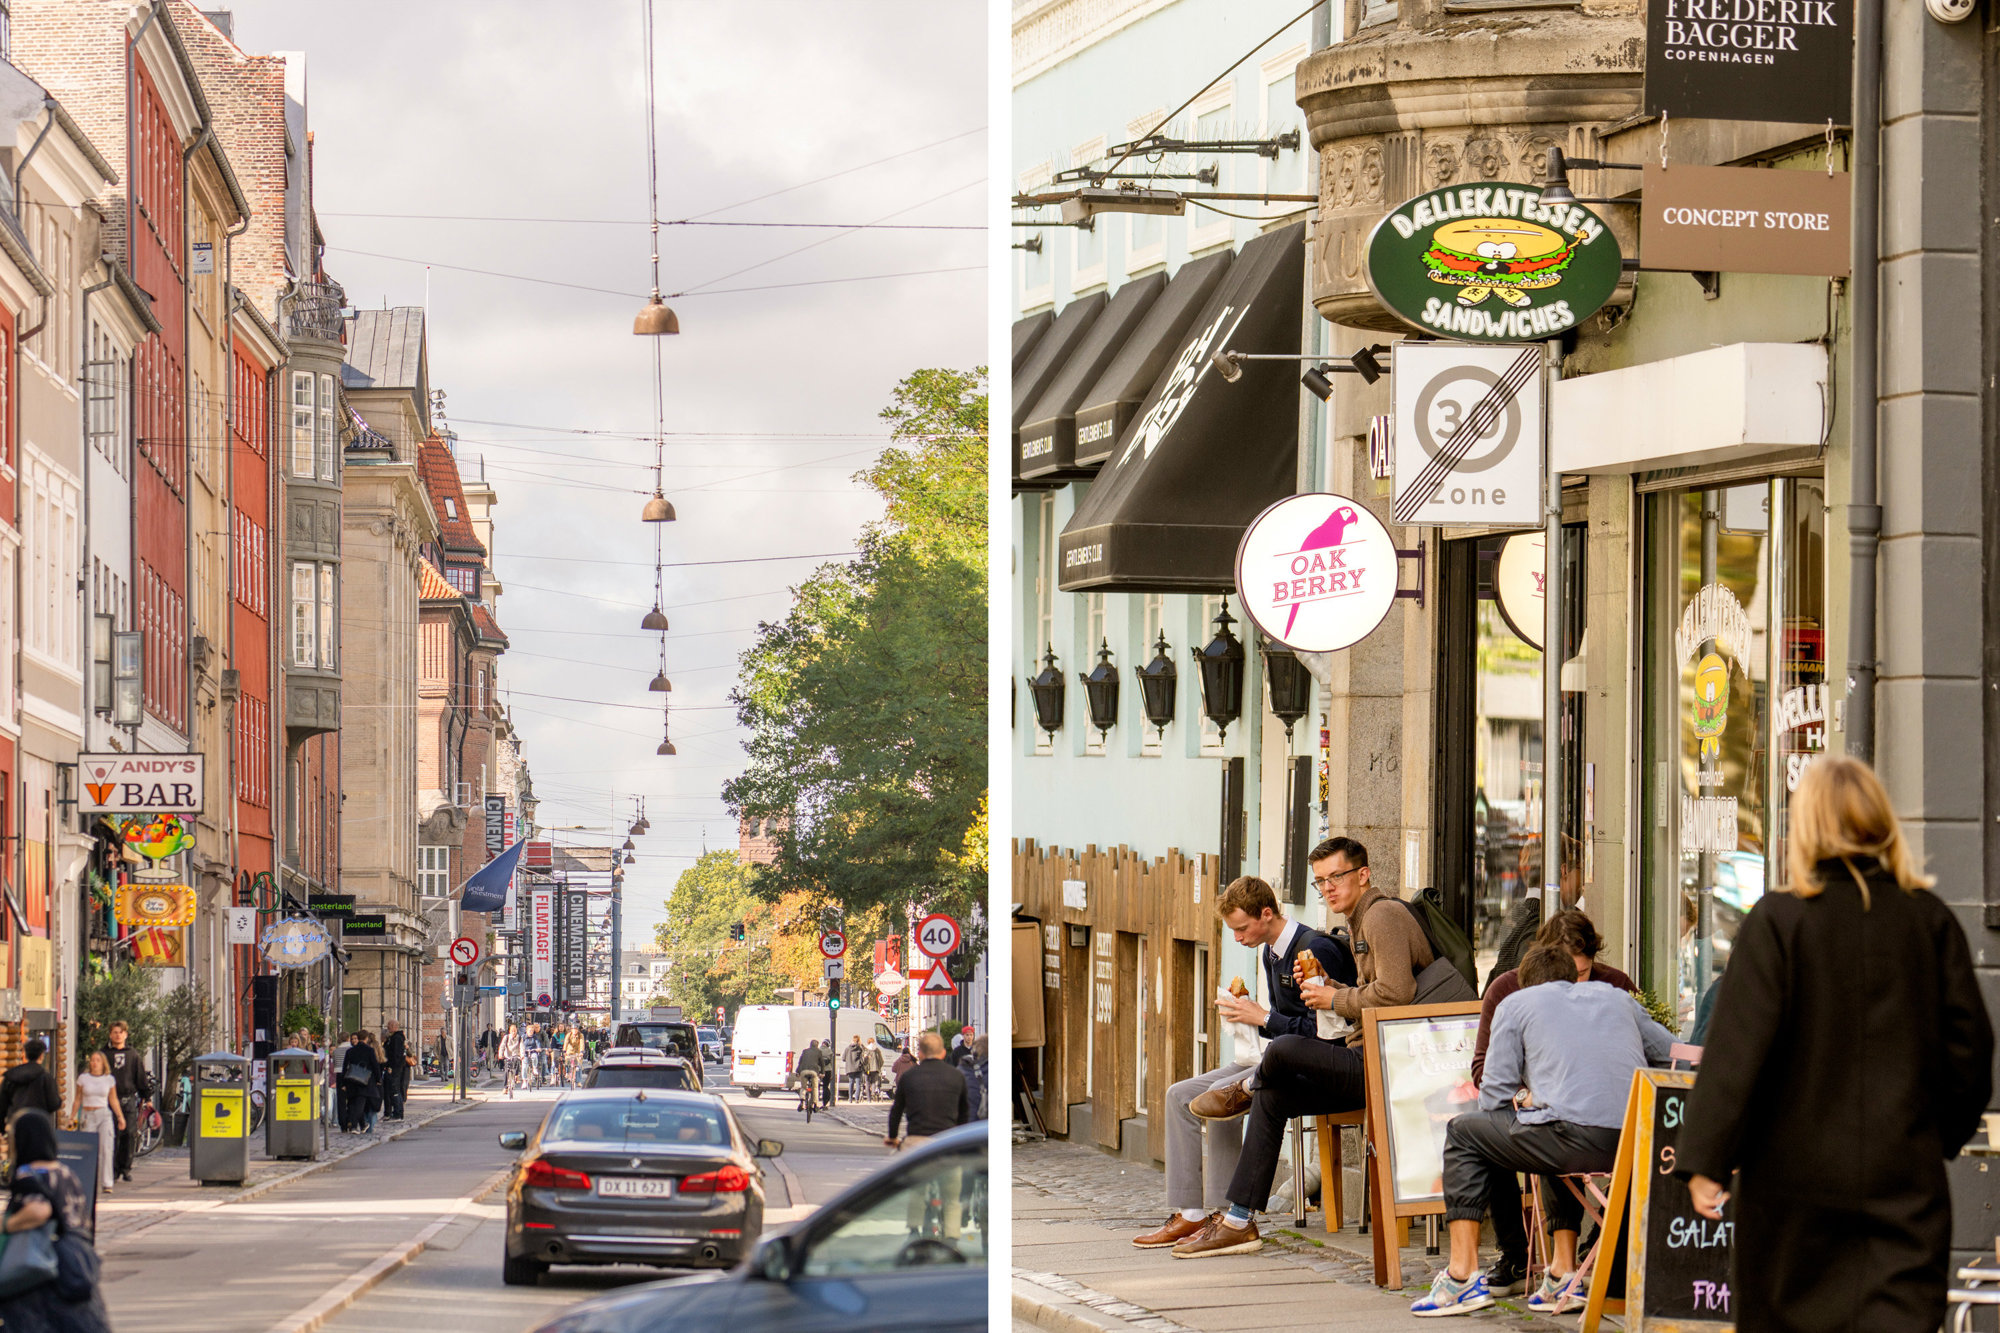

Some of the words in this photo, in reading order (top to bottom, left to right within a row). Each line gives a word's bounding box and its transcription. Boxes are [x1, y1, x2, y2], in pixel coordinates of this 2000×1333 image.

[1665, 0, 1838, 26] FREDERIK
[1665, 21, 1799, 51] BAGGER
[1664, 50, 1775, 65] COPENHAGEN
[1390, 187, 1603, 246] DÆLLEKATESSEN
[1663, 207, 1759, 228] CONCEPT
[1764, 211, 1830, 231] STORE
[1421, 297, 1576, 338] SANDWICHES
[1434, 399, 1500, 440] 30
[1368, 415, 1391, 481] OA
[1429, 483, 1507, 505] Zone
[1291, 549, 1347, 576] OAK
[1272, 568, 1366, 602] BERRY
[1773, 682, 1827, 737] DÆLL
[120, 760, 196, 774] ANDY'S
[120, 783, 196, 807] BAR
[311, 903, 352, 911] posterland
[346, 921, 383, 930] posterland
[536, 895, 549, 963] FILMTAGET
[570, 894, 584, 981] CINEMATEKET
[923, 927, 952, 945] 40
[1096, 983, 1112, 1024] 1999
[604, 1181, 620, 1193] DX
[626, 1182, 637, 1194] 11
[641, 1182, 665, 1194] 623
